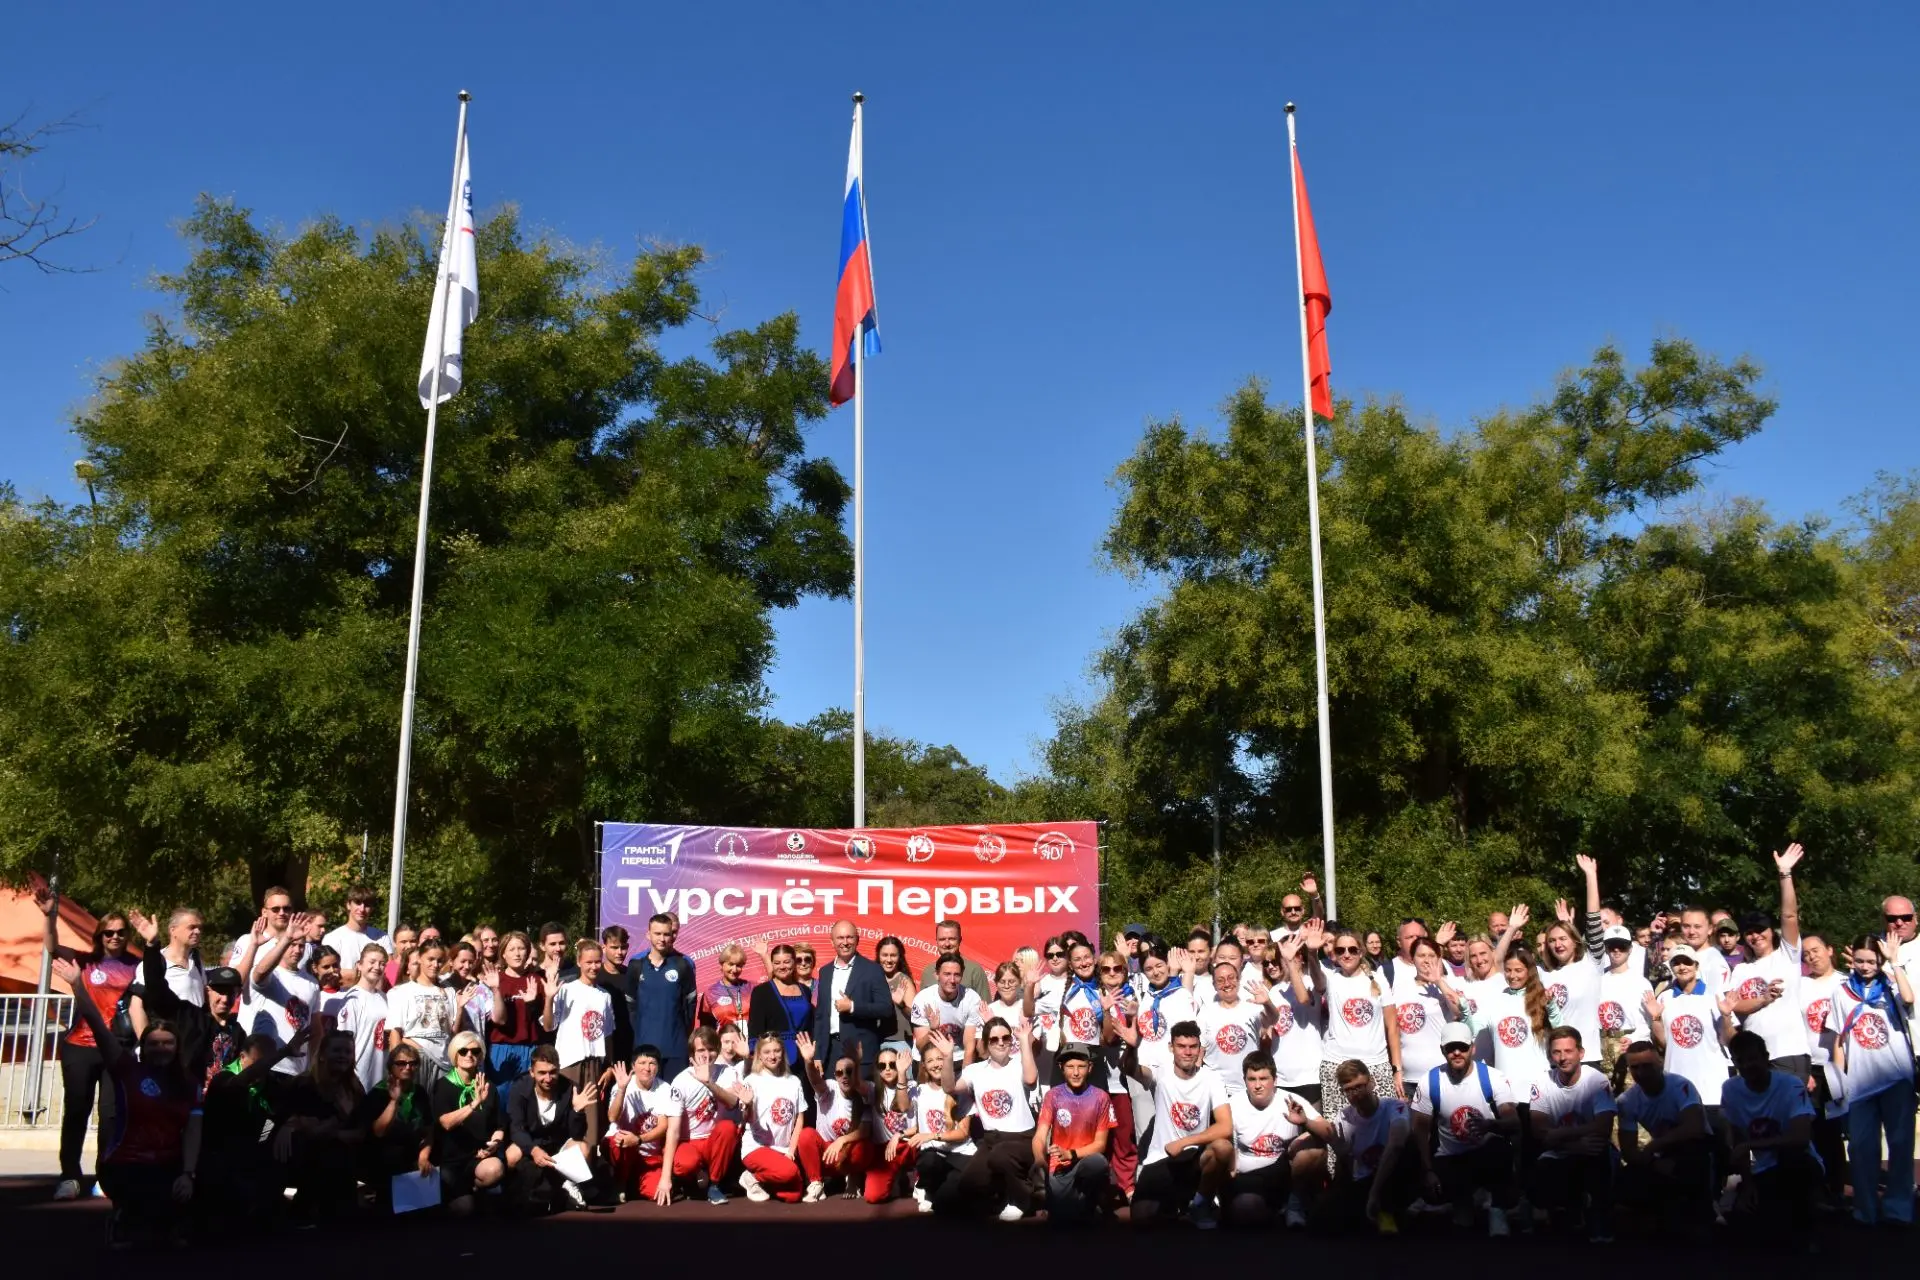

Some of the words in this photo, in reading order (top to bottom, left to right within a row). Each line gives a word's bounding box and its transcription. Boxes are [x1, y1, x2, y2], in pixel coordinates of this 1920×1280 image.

[624, 846, 666, 854] ГРАНТЫ
[621, 857, 666, 865] ПЕРВЫХ
[616, 879, 844, 924] Турслёт
[857, 879, 1079, 923] Первых
